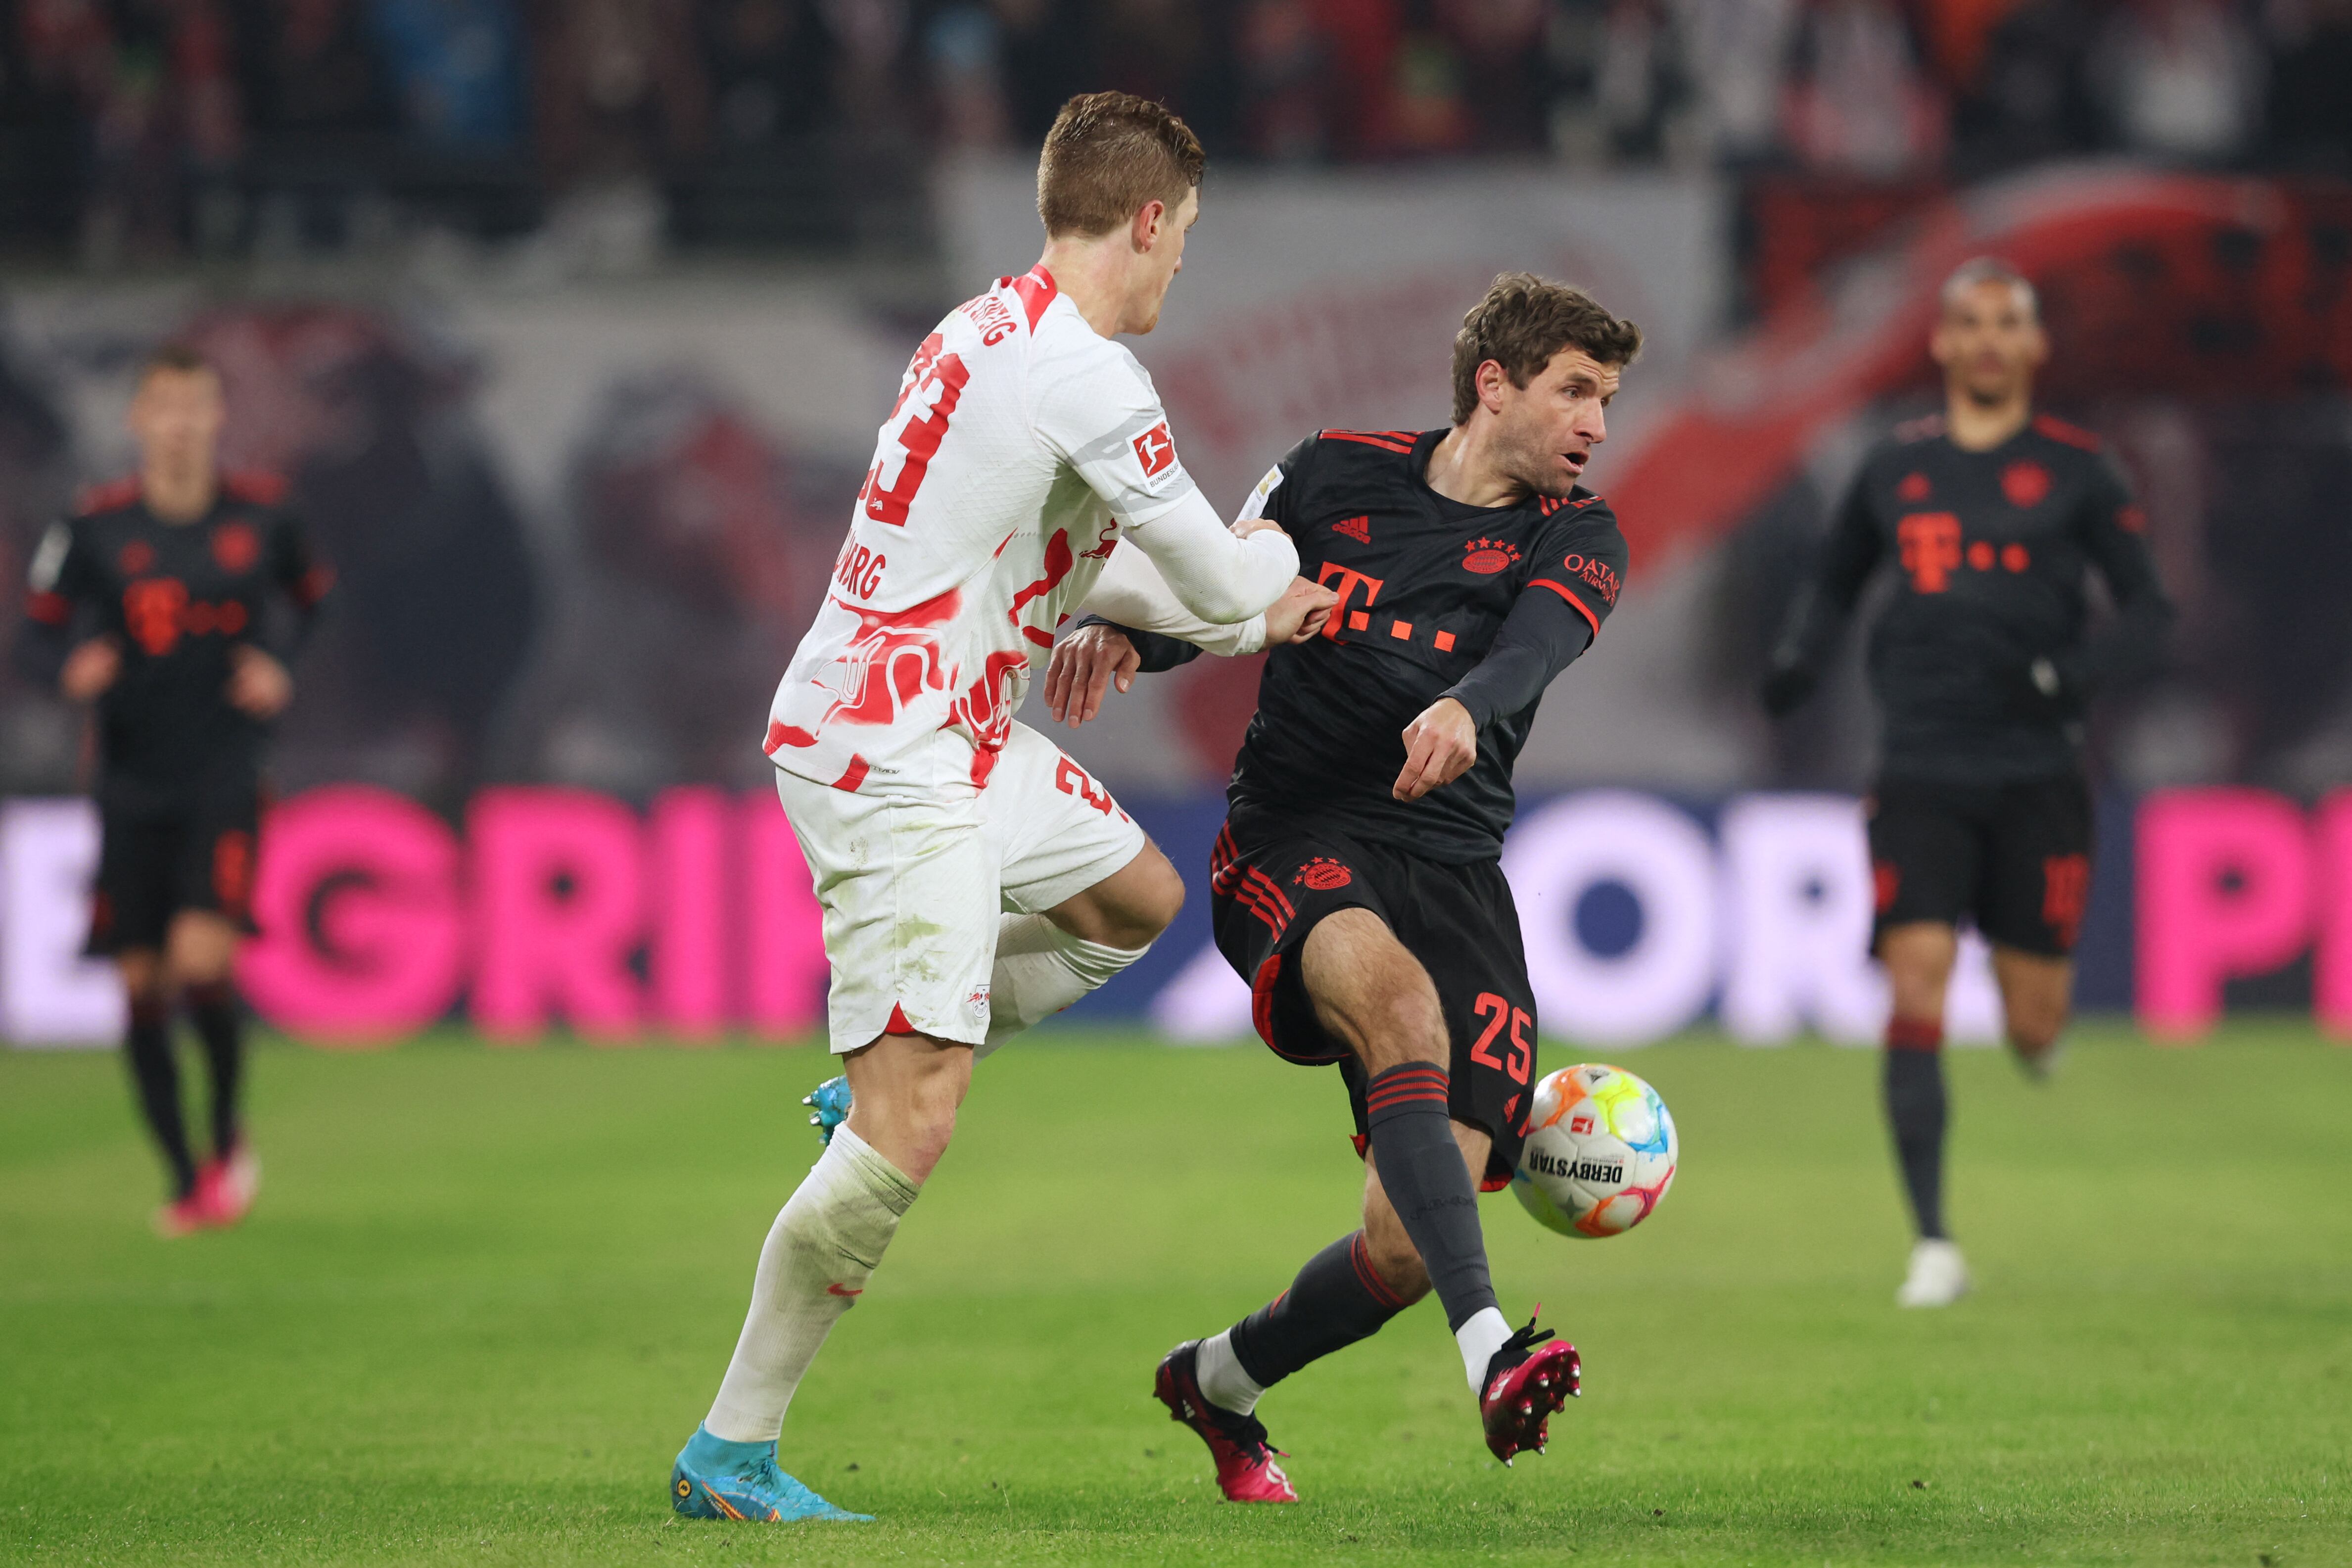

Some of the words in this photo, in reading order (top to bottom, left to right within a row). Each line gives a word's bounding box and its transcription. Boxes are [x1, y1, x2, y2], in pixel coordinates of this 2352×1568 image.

[1564, 554, 1620, 598] QATAR
[1470, 992, 1532, 1086] 25
[1529, 1150, 1623, 1184] DERBYSTAR
